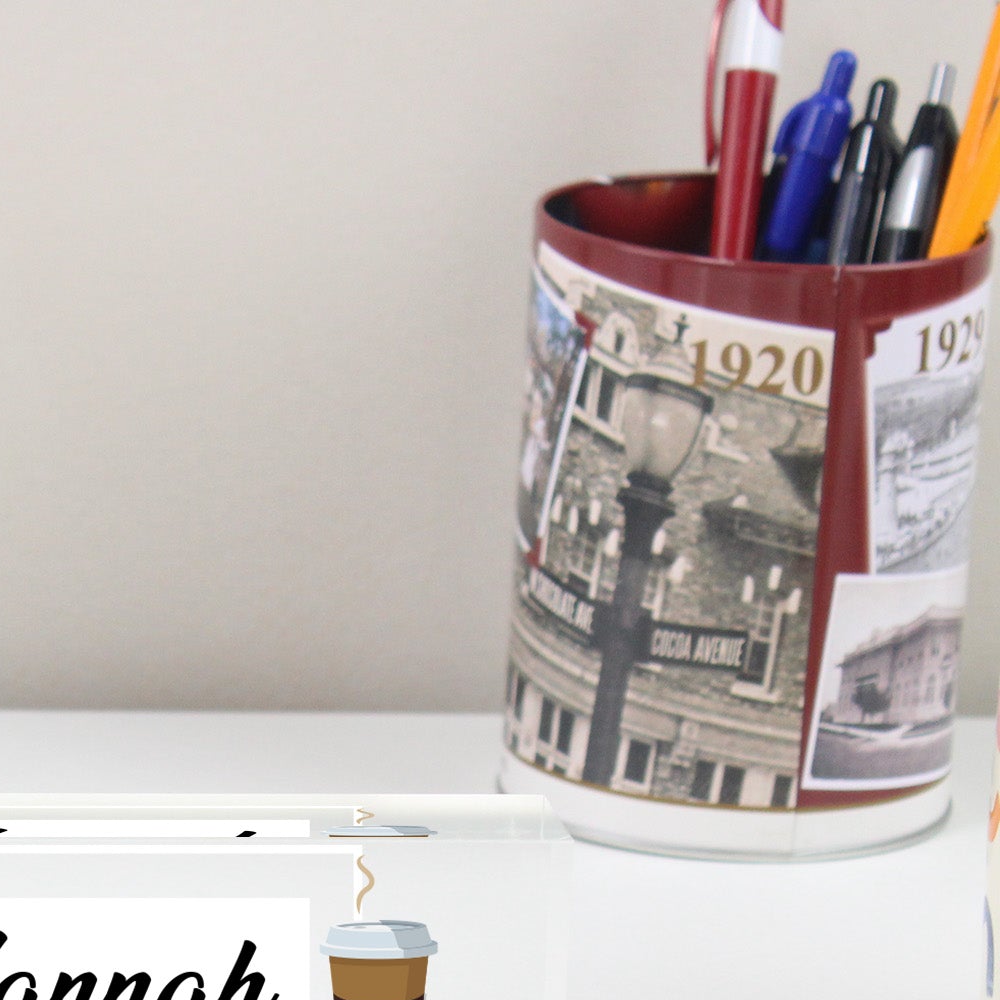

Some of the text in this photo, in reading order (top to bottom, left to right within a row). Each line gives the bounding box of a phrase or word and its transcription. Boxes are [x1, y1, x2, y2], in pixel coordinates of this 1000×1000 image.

[690, 338, 824, 396] 1920
[916, 308, 985, 374] 1929
[651, 628, 745, 667] COCOA AVENUE
